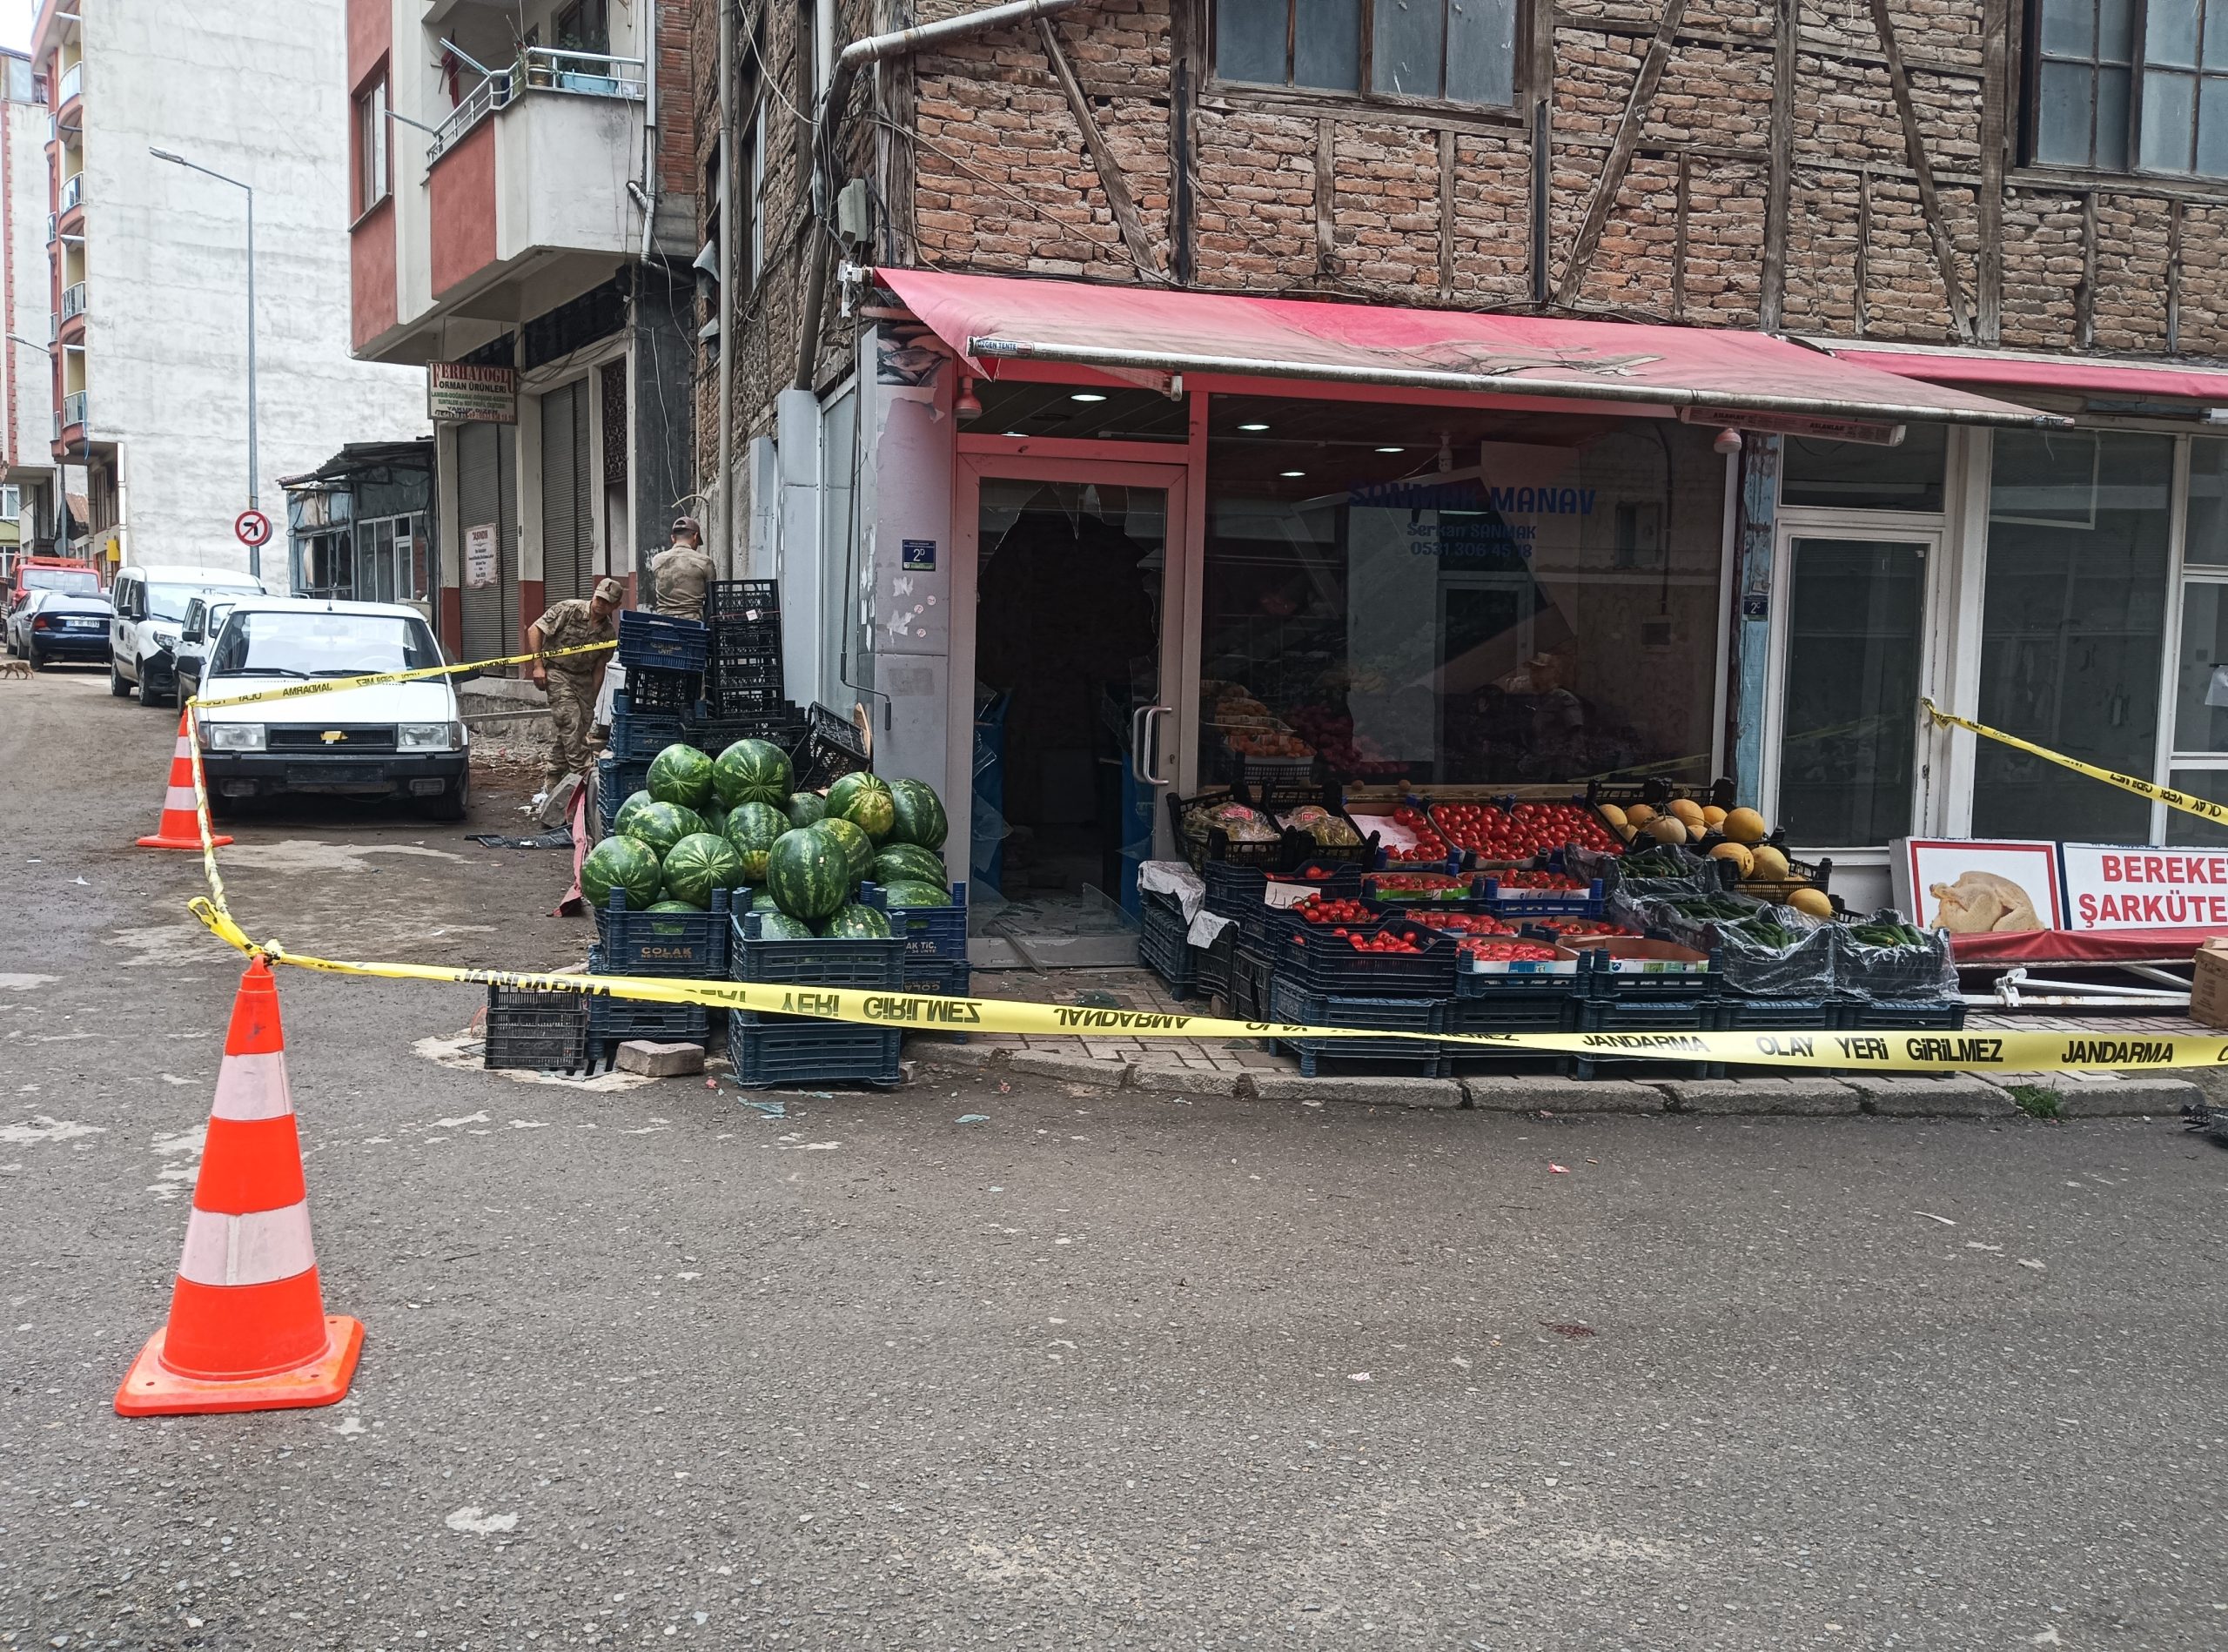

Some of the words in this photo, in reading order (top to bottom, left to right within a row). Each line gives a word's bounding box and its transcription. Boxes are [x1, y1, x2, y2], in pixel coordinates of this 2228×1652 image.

[439, 381, 466, 390] ORMAN
[1489, 487, 1597, 515] MANAV
[1406, 521, 1466, 537] Serkan
[1470, 524, 1538, 540] SANMAK
[1410, 541, 1450, 557] 0531
[2102, 855, 2228, 884] BEREKE
[2078, 890, 2228, 928] ŞARKÜTE
[1582, 1035, 1712, 1052] JANDARMA
[1755, 1036, 1815, 1058] OLAY
[2061, 1039, 2174, 1064] JANDARMA
